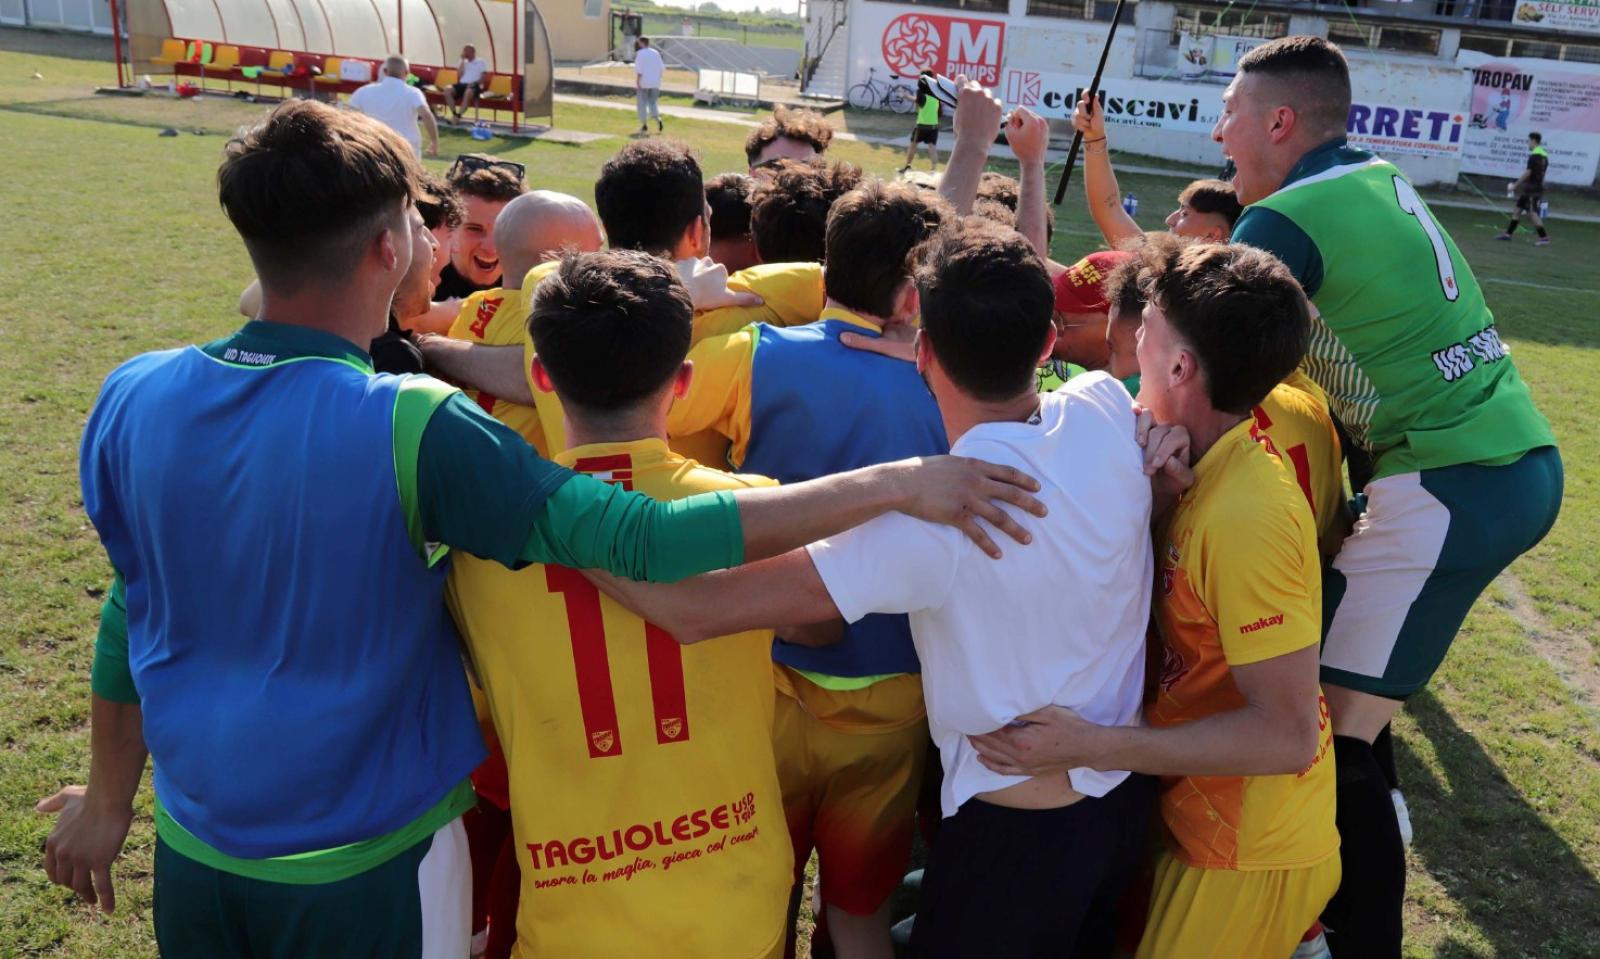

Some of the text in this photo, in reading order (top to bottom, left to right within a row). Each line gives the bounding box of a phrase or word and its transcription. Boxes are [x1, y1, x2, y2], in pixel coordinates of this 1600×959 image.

[1567, 5, 1600, 17] SERVI
[948, 21, 1001, 65] M
[946, 62, 996, 83] PUMPS
[1043, 87, 1199, 122] edlscavi
[1346, 103, 1463, 143] RRETi
[1391, 174, 1460, 302] 1
[1239, 613, 1284, 635] makay
[732, 791, 754, 813] USD
[526, 803, 730, 870] TAGLIOLESE
[534, 876, 577, 889] onora
[582, 868, 597, 884] la
[602, 856, 656, 882] maglia,
[662, 847, 702, 870] gioca
[706, 834, 727, 854] col
